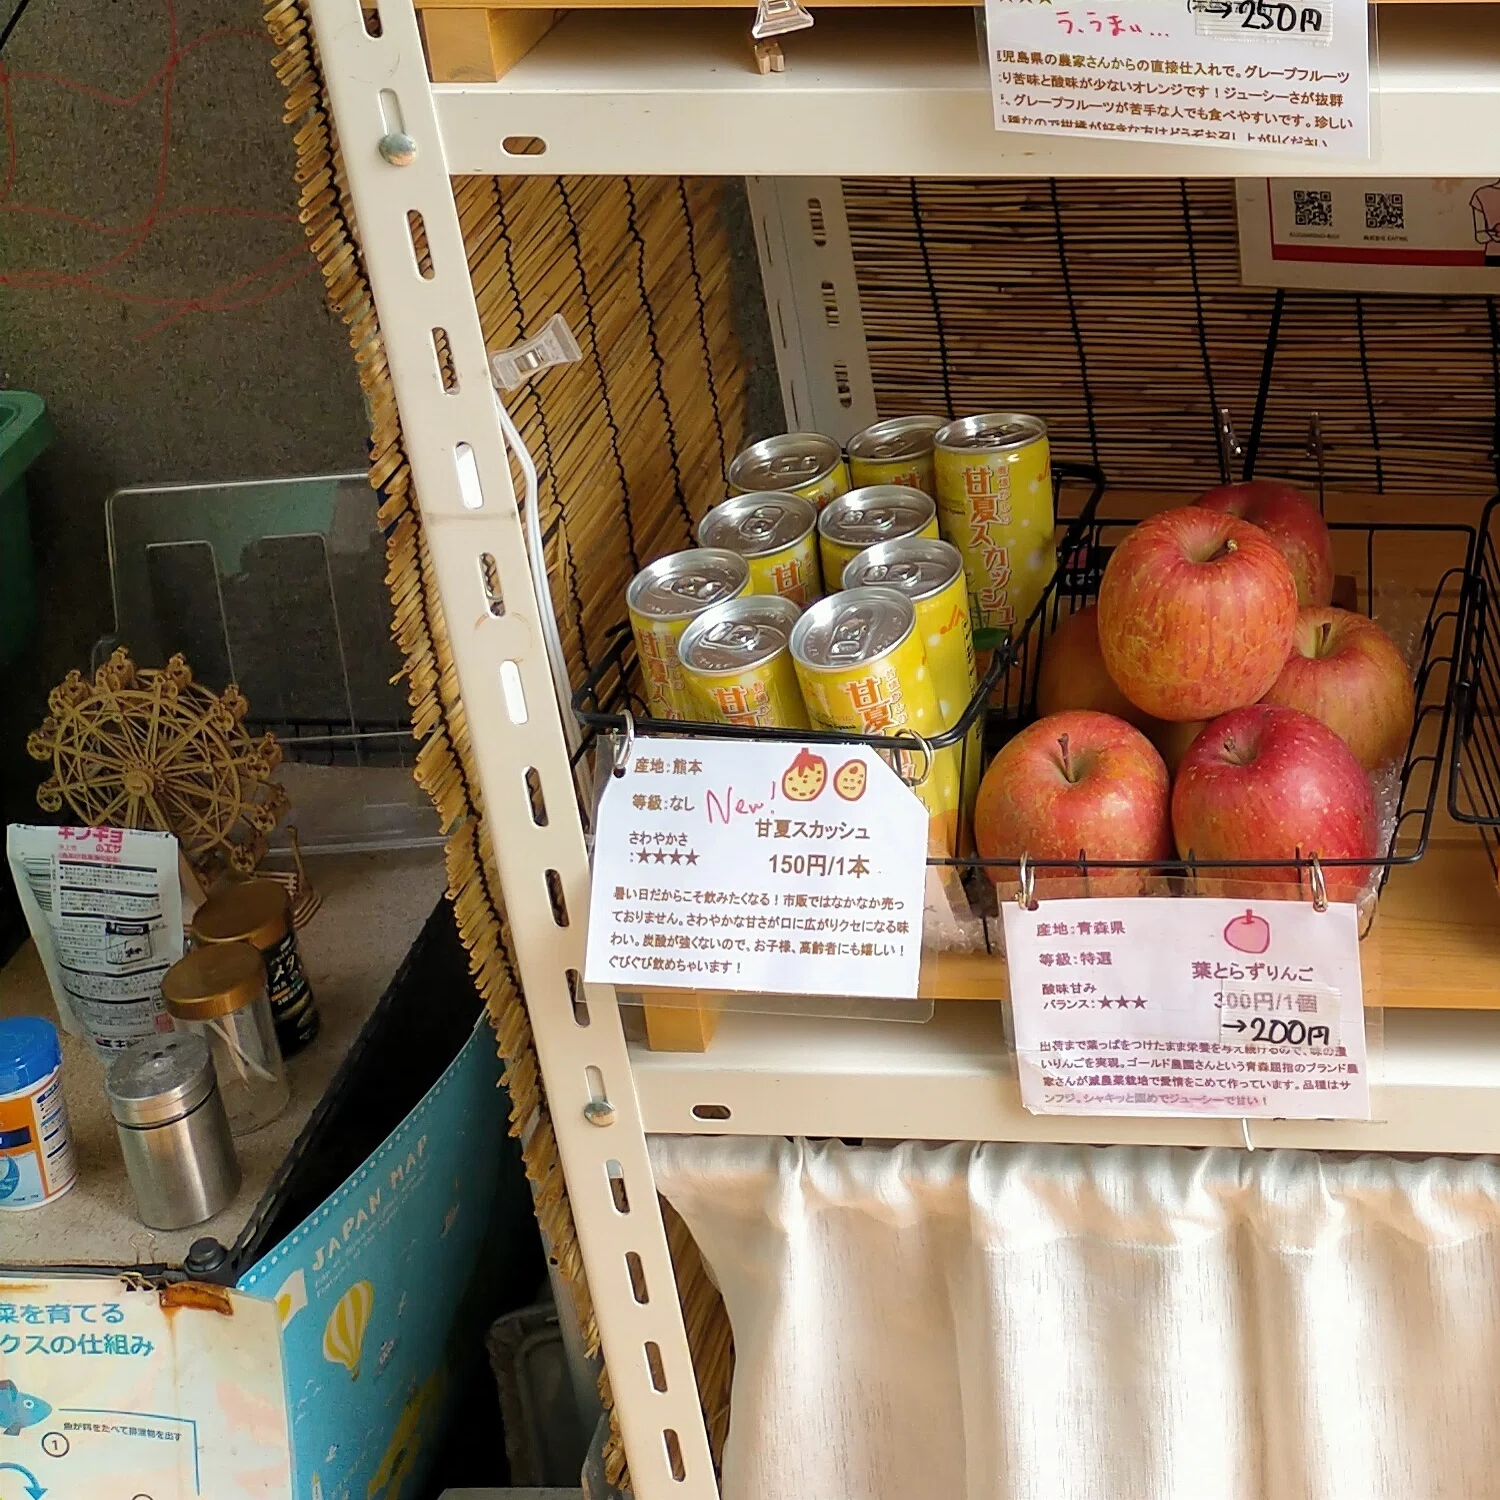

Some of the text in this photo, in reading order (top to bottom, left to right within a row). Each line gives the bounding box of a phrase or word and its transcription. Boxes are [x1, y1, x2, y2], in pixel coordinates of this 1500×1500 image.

[997, 49, 1350, 84] 児島県の農家さんからの直接仕入れで。グレープフルーツ
[999, 72, 1344, 108] り苦味と酸味が少ないオレンジです!ジューシーさが抜群
[1000, 93, 1352, 129] 、グレープフルーツが苦手な人でも食べやすいです。珍しい
[634, 757, 703, 775] 産地:熊本
[632, 794, 695, 812] 等級:なし
[629, 831, 688, 846] さわやかさ
[755, 819, 870, 841] 甘夏スカッシュ
[769, 855, 870, 879] 150円/1本
[1036, 921, 1126, 937] 産地:青森県
[1039, 952, 1112, 967] 等級:特選
[1192, 961, 1313, 982] 葉とらずりんご
[1042, 982, 1097, 995] 酸味甘み
[1214, 992, 1318, 1013] 300円/1個
[1250, 1018, 1330, 1046] 200円
[312, 1187, 381, 1271] JAPAN
